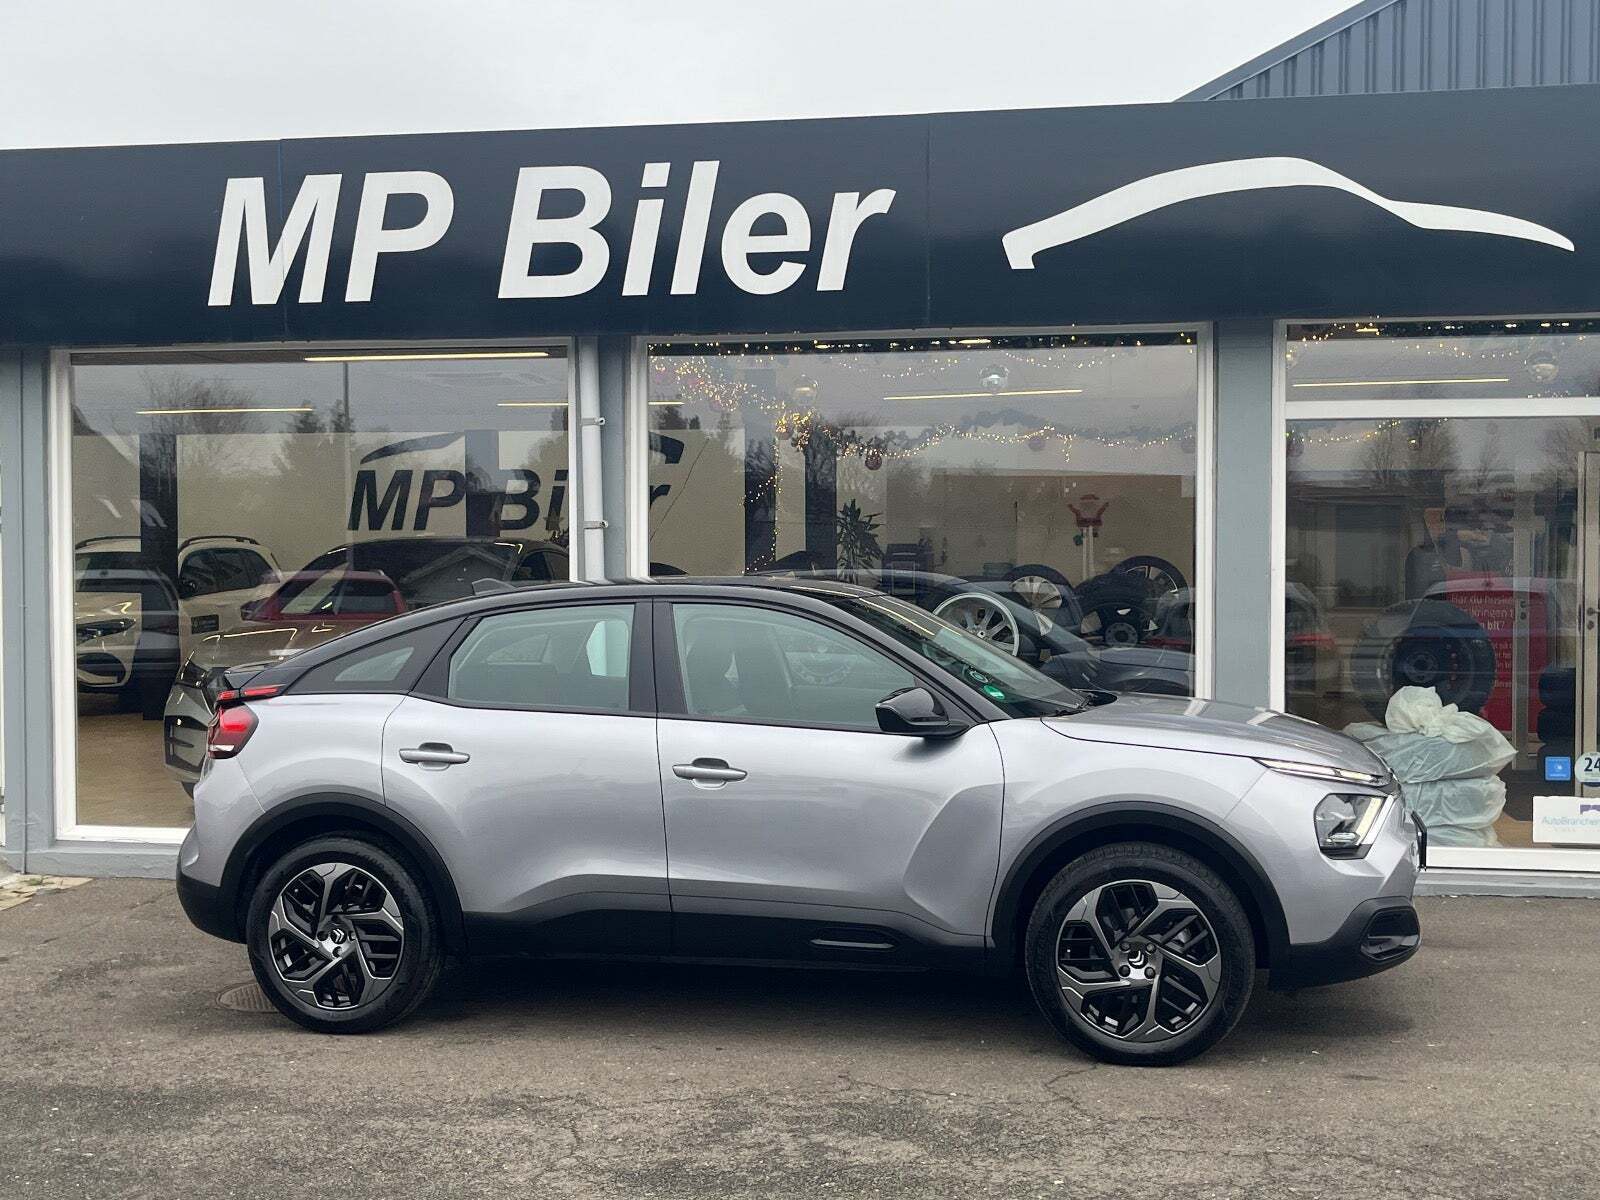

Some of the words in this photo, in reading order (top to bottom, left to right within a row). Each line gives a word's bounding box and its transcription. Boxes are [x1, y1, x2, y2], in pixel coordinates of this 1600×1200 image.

[207, 170, 455, 307] MP
[497, 160, 897, 299] Biler
[347, 469, 466, 531] MP
